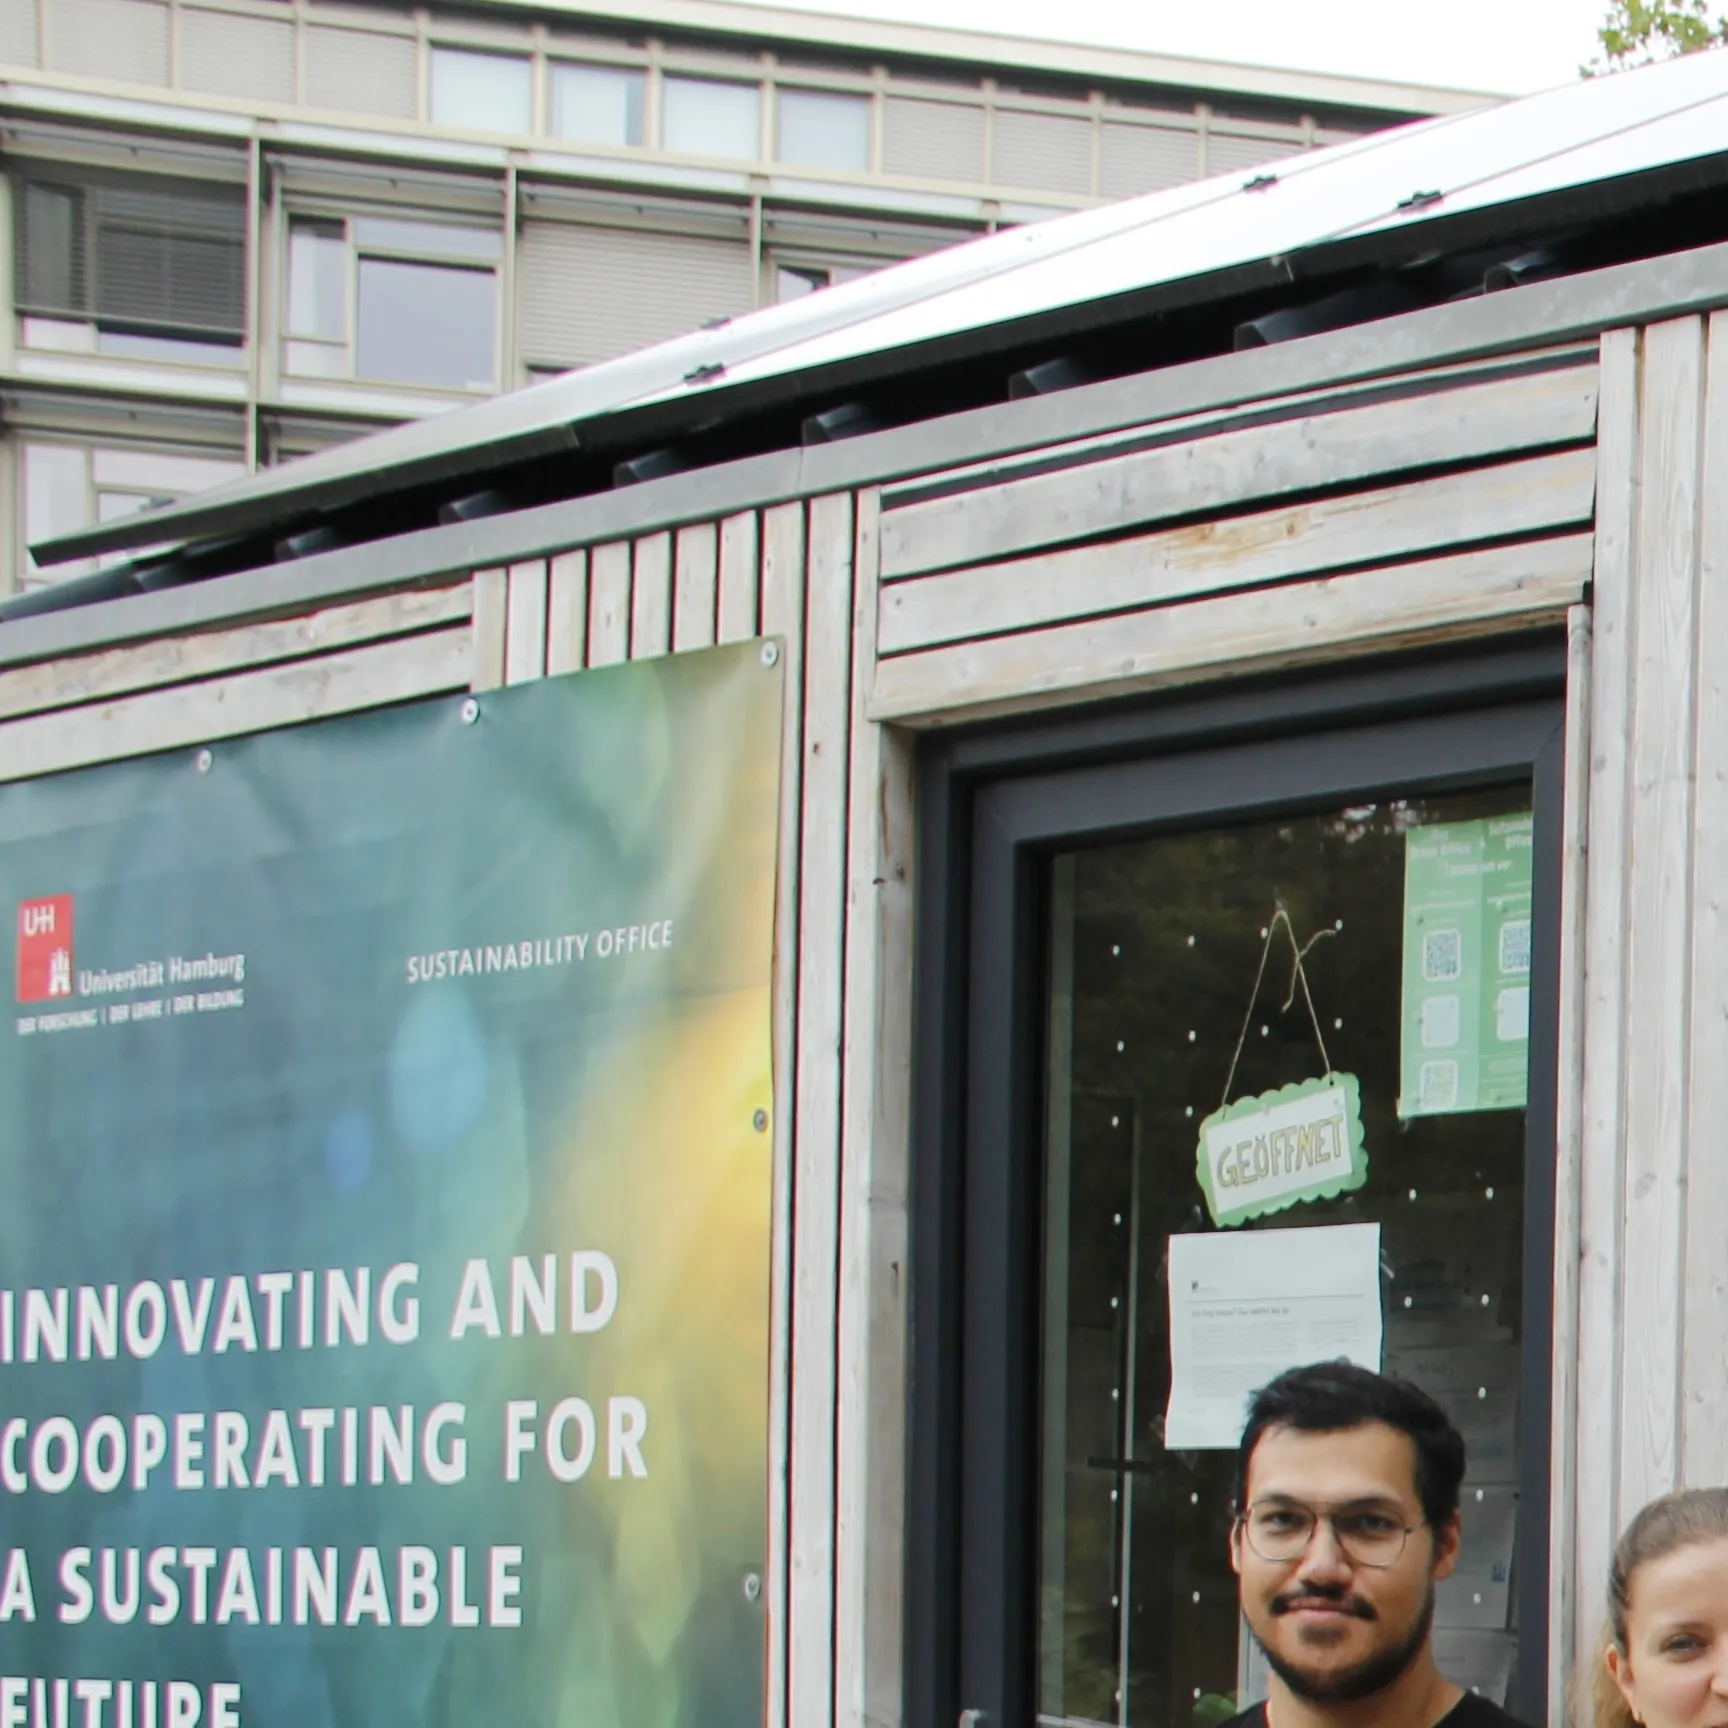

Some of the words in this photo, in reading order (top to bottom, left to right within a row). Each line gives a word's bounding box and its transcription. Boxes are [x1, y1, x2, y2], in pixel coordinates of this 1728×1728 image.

[79, 960, 165, 997] Universität
[169, 951, 246, 983] Hamburg
[406, 932, 590, 985] SUSTAINABILITY
[596, 919, 675, 960] OFFICE
[1216, 1114, 1346, 1191] GEÖFFNET
[0, 1262, 421, 1364] INNOVATING
[449, 1248, 620, 1339] AND
[0, 1400, 468, 1495] COOPERATING
[504, 1394, 650, 1483] FOR
[0, 1547, 37, 1624] A
[57, 1545, 525, 1629] SUSTAINABLE
